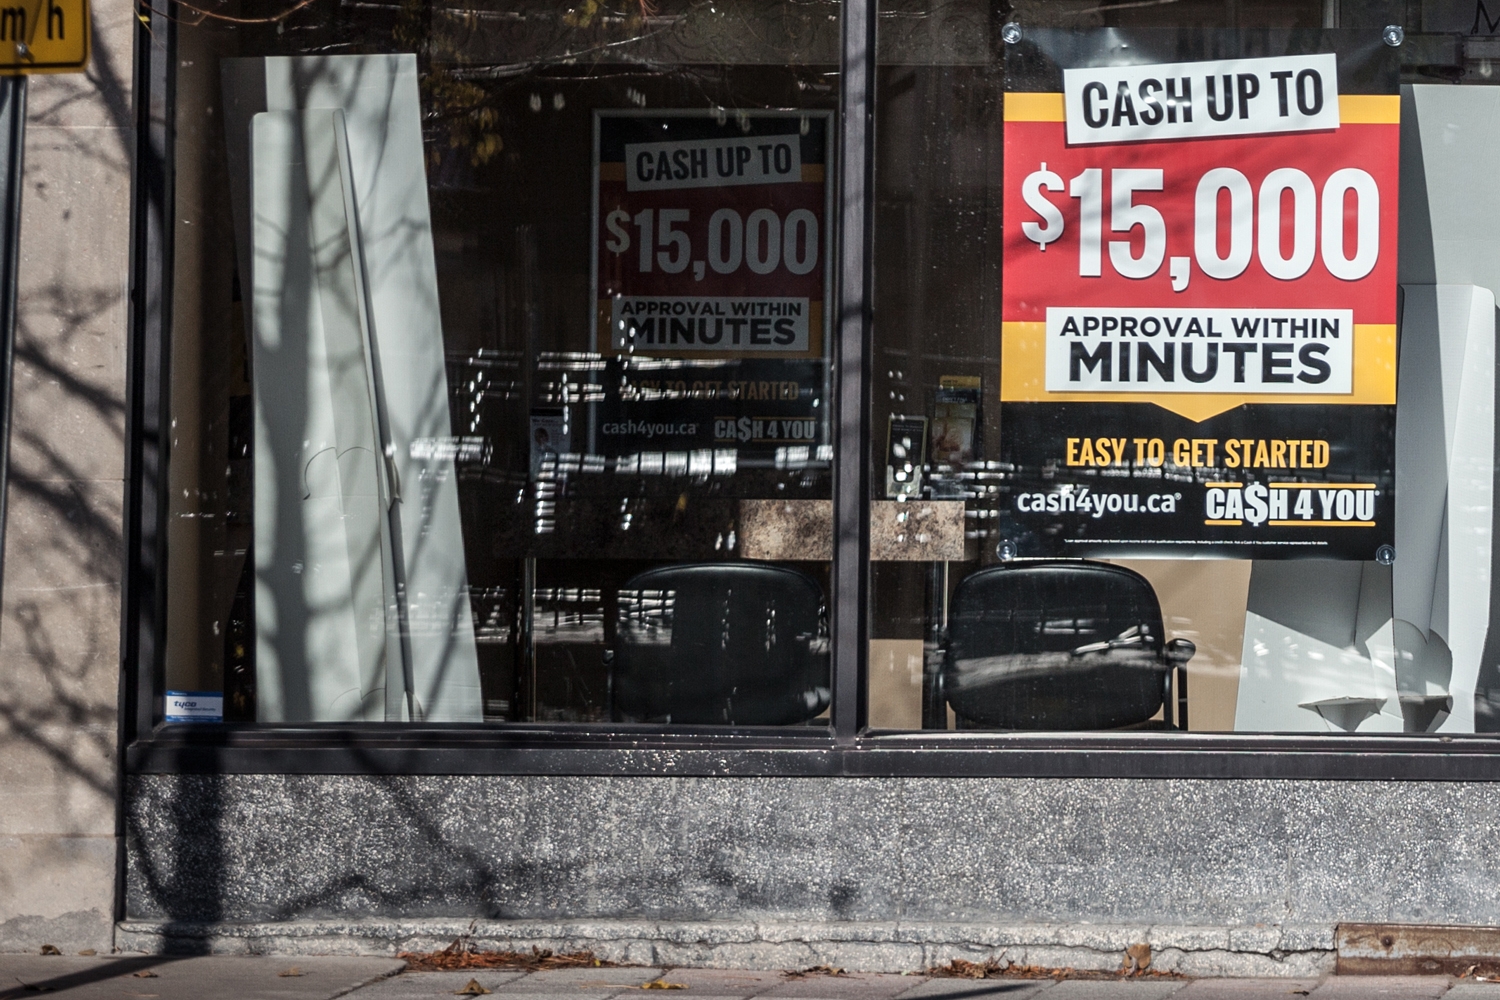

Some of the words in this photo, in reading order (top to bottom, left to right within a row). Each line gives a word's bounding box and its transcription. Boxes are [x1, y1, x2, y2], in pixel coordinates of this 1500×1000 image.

[1082, 77, 1192, 128] CASH
[1206, 72, 1260, 122] UP
[1270, 68, 1324, 117] TO
[636, 148, 708, 182] CASH
[716, 146, 751, 178] UP
[758, 143, 792, 175] TO
[605, 205, 819, 281] $15,000
[1021, 162, 1380, 292] $15,000
[621, 301, 725, 316] APPROVAL
[731, 302, 801, 316] WITHIN
[626, 318, 796, 345] MINUTES
[1060, 316, 1222, 338] APPROVAL
[1231, 317, 1340, 339] WITHIN
[1069, 341, 1332, 385] MINUTES
[728, 381, 799, 400] STARTED
[714, 416, 764, 443] CA$H
[767, 422, 778, 438] 4
[782, 421, 815, 439] YOU
[1066, 437, 1127, 467] EASY
[1133, 438, 1165, 467] TO
[1173, 438, 1218, 468] GET
[1225, 439, 1330, 469] STARTED
[1205, 482, 1287, 527] CA$H
[1294, 490, 1313, 519] 4
[1321, 489, 1375, 520] YOU
